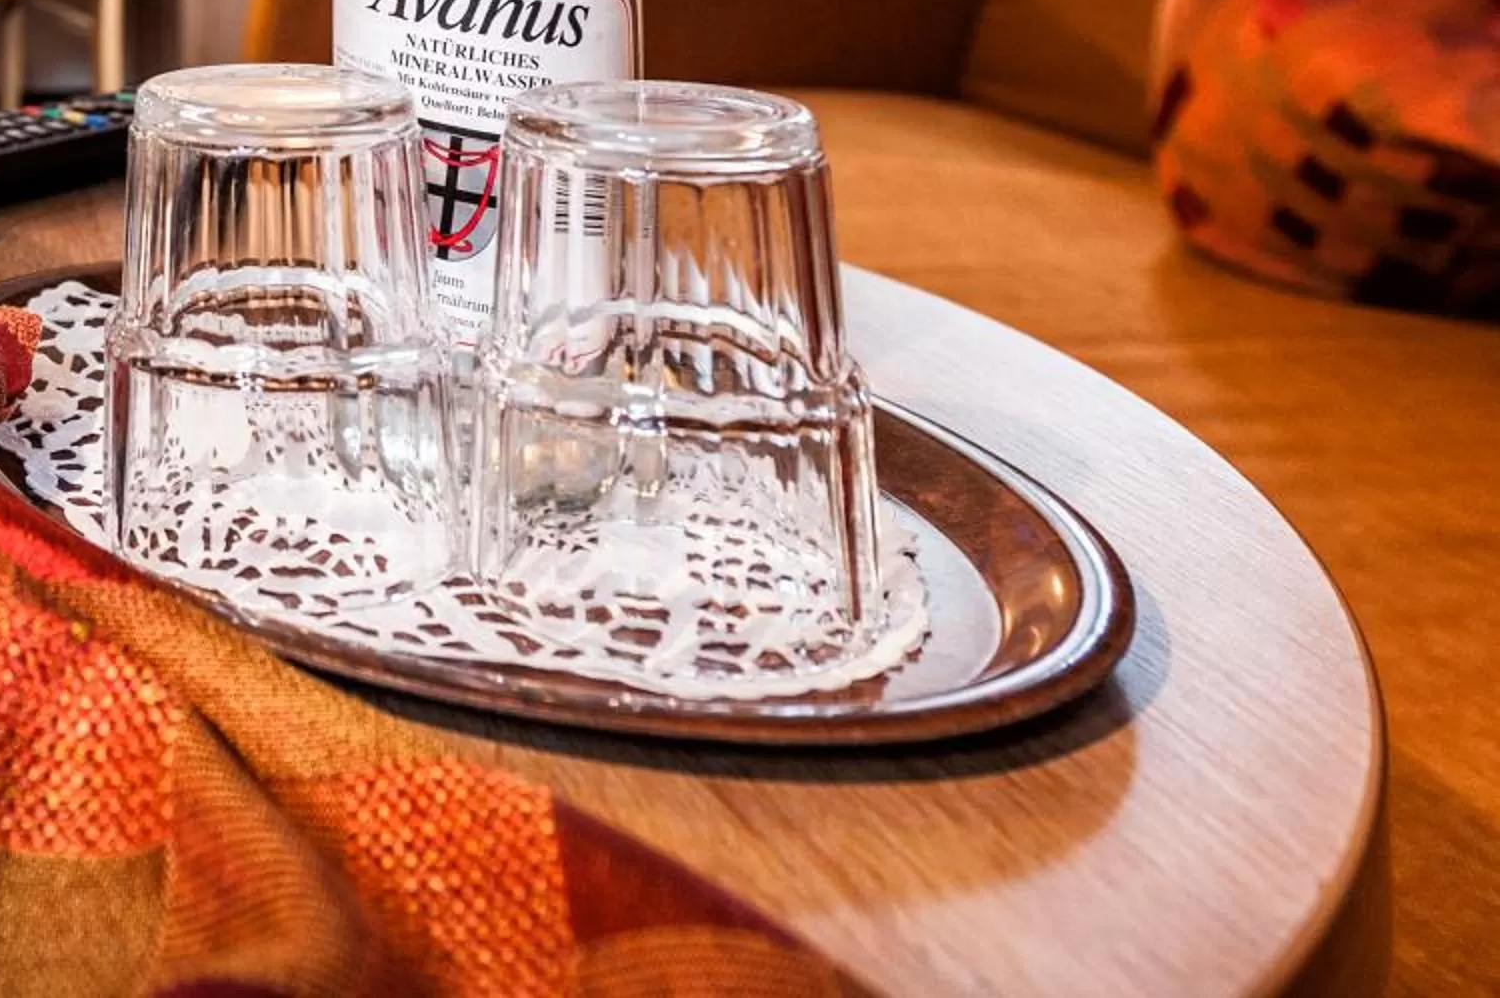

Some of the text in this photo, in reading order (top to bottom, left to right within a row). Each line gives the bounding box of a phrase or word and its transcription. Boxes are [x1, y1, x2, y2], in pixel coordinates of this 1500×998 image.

[405, 33, 541, 71] NATÜRLICHES
[418, 76, 495, 101] Kohlensäure
[421, 94, 474, 116] Quellort:
